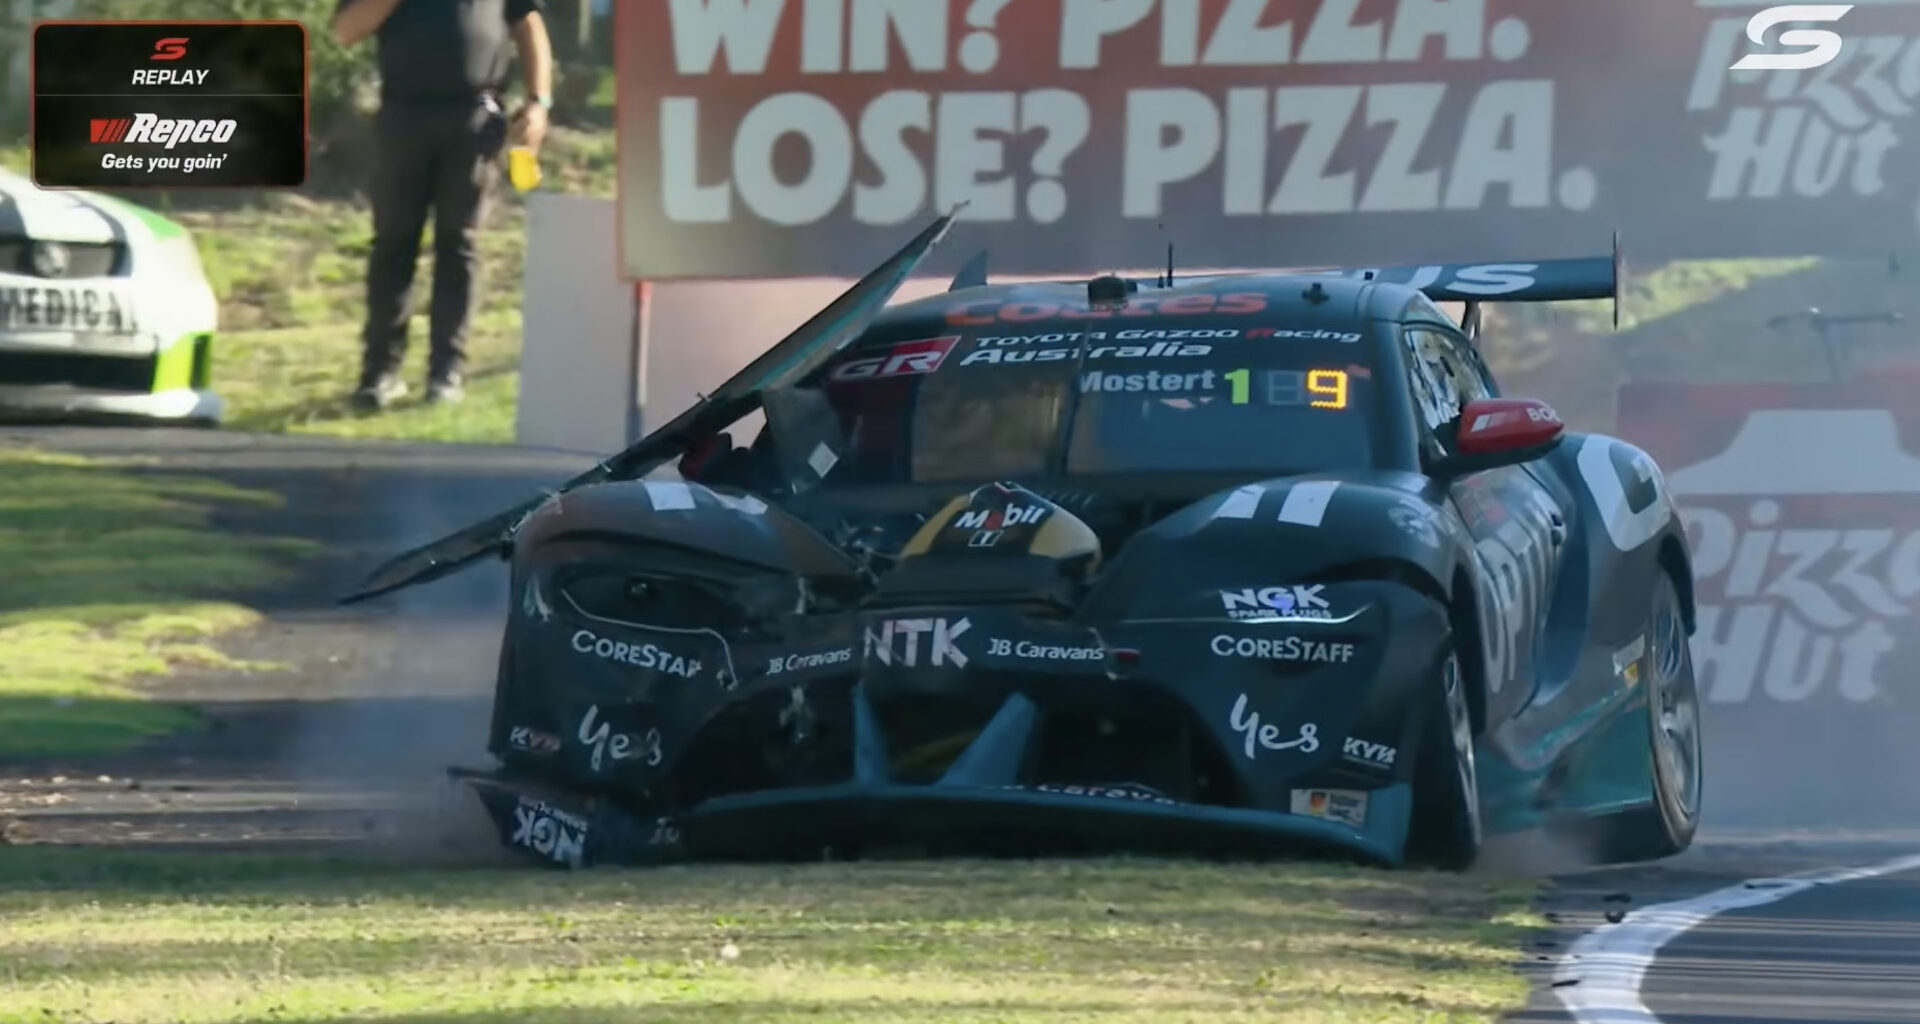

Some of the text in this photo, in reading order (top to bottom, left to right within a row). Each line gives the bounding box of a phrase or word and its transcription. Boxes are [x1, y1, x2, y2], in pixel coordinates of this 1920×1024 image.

[669, 0, 1530, 74] WIN? PIZZA.
[660, 79, 1596, 226] LOSE? PIZZA.
[1703, 105, 1898, 200] Hut
[976, 328, 1362, 347] TOYOTA GAZOO Racing
[829, 352, 938, 379] GR
[959, 342, 1213, 366] Australia
[1224, 368, 1250, 404] 1
[954, 503, 1046, 528] Mobil
[1219, 583, 1330, 610] NGK
[864, 617, 971, 668] NTK
[986, 638, 1105, 661] JB Caravans
[1690, 605, 1895, 702] Hut
[766, 658, 783, 675] JB
